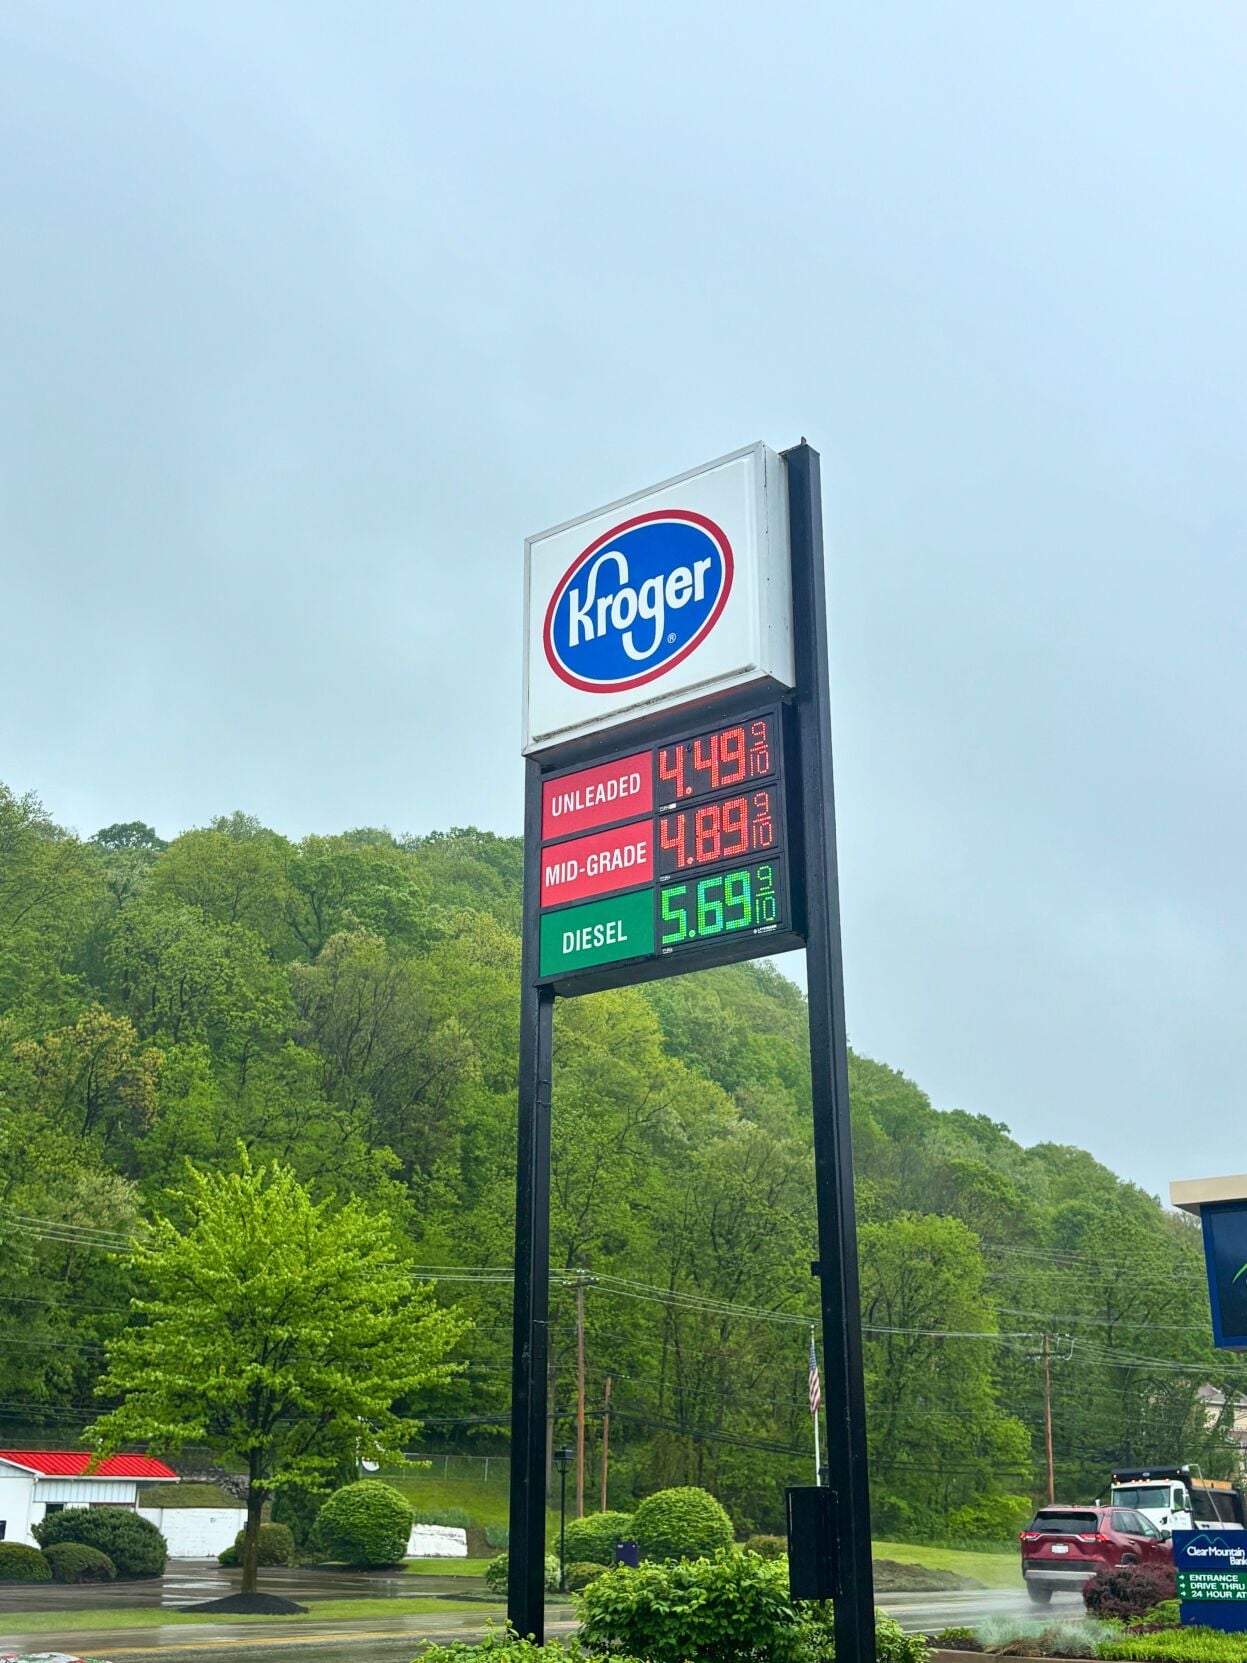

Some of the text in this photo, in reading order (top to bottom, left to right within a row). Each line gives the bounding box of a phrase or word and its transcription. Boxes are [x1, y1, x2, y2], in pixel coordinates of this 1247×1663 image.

[569, 551, 711, 660] Kroger
[659, 727, 746, 798] 4.49
[551, 772, 641, 817] UNLEADED
[660, 797, 749, 868] 4.89
[545, 841, 647, 888] MID-GRADE
[661, 870, 752, 945] 5.69
[562, 920, 628, 954] DIESEL
[1189, 1574, 1239, 1582] ENTRANCE
[1190, 1582, 1246, 1590] DRIVE THRU
[1191, 1590, 1203, 1598] 24
[1206, 1590, 1233, 1598] HOUR
